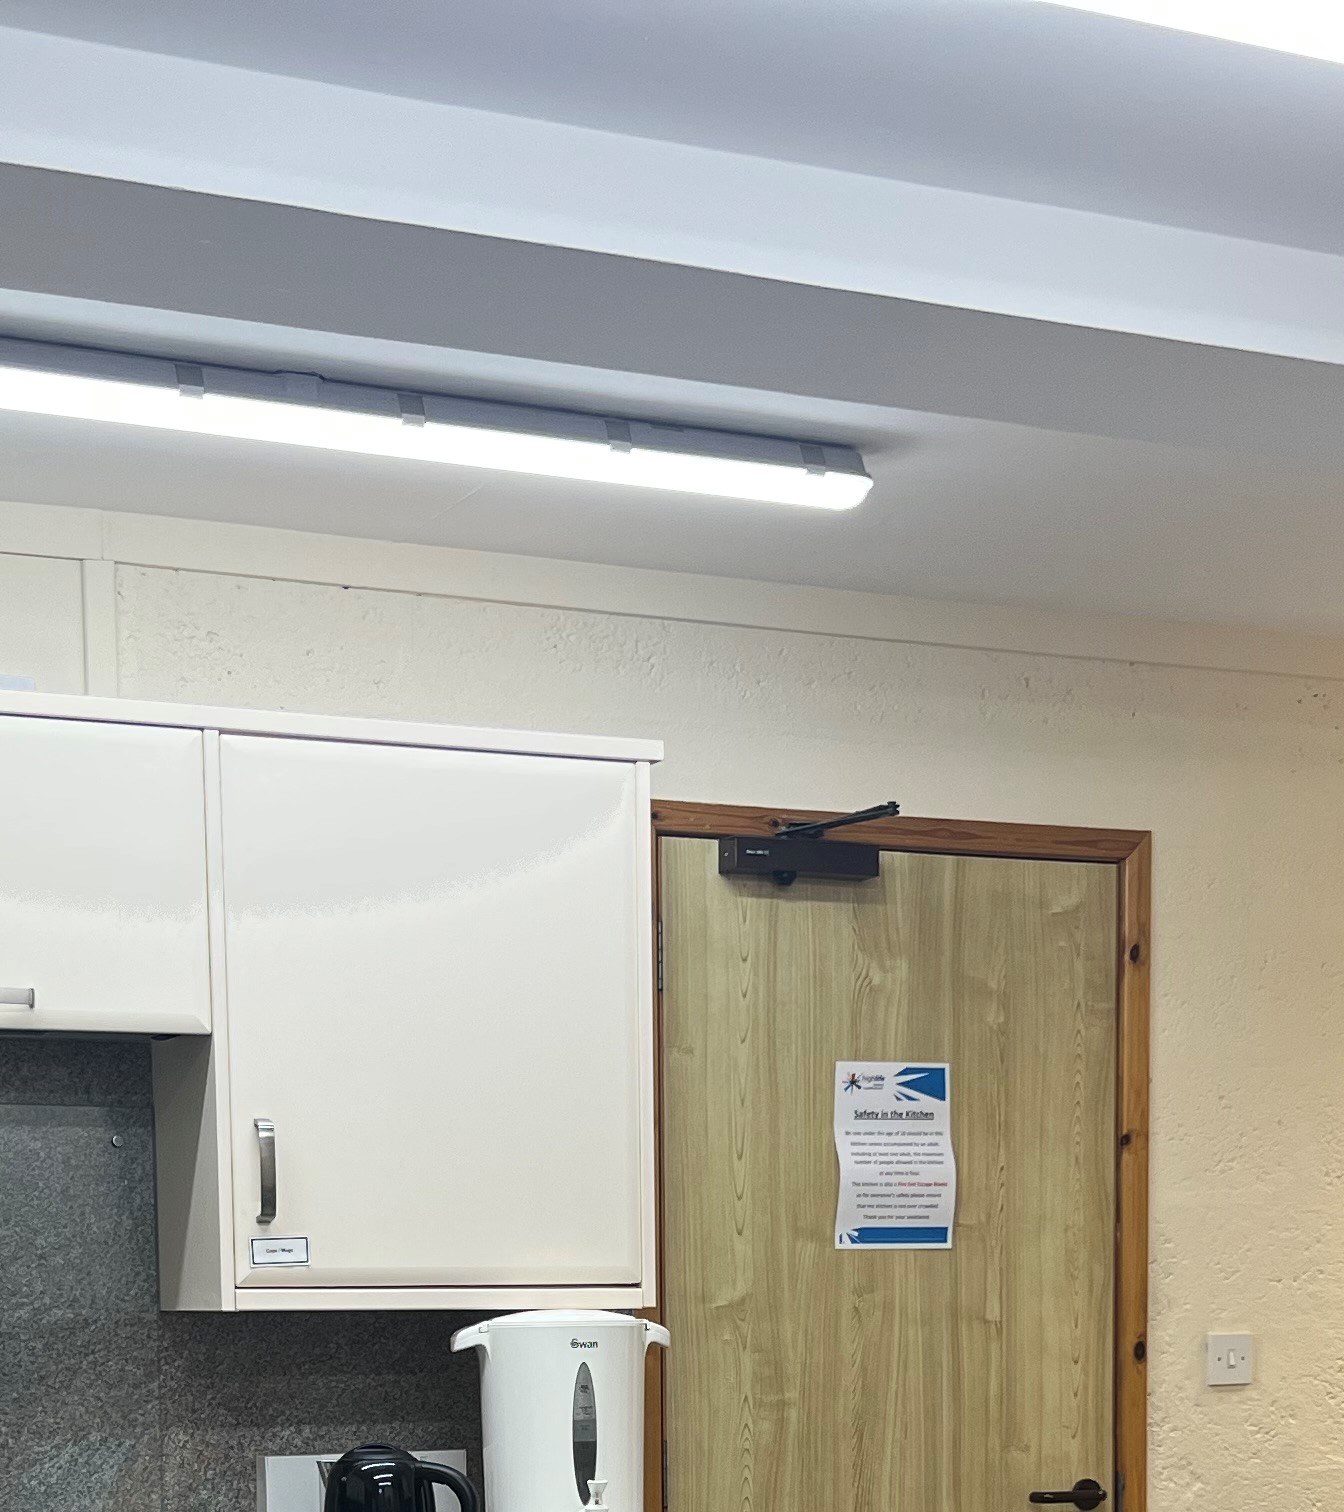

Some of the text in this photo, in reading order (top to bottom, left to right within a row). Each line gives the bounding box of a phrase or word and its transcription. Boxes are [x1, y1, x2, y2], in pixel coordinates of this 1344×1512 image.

[854, 1110, 934, 1120] Safety in the Kitchen
[570, 1338, 598, 1348] Swan
